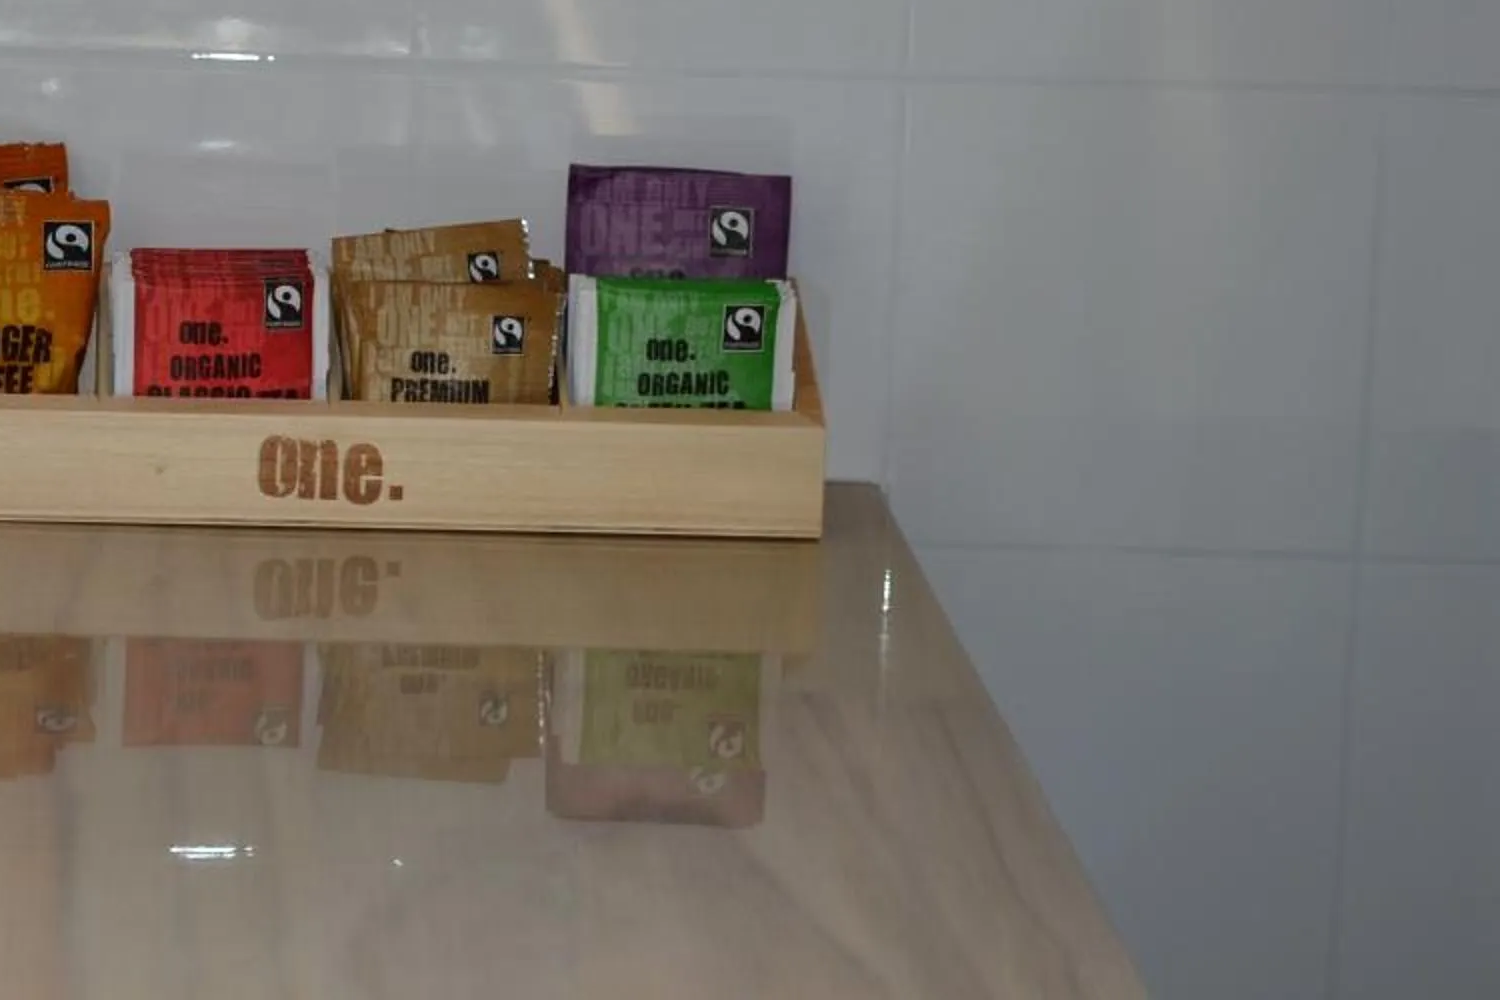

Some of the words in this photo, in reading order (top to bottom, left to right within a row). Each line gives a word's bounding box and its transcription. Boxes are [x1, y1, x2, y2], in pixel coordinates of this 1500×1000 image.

[179, 320, 229, 346] one.
[410, 349, 457, 375] one.
[645, 337, 697, 363] one.
[169, 353, 262, 381] ORGANIC
[390, 376, 490, 404] PREMIUM
[636, 368, 730, 397] ORGANIC
[257, 434, 404, 506] one.
